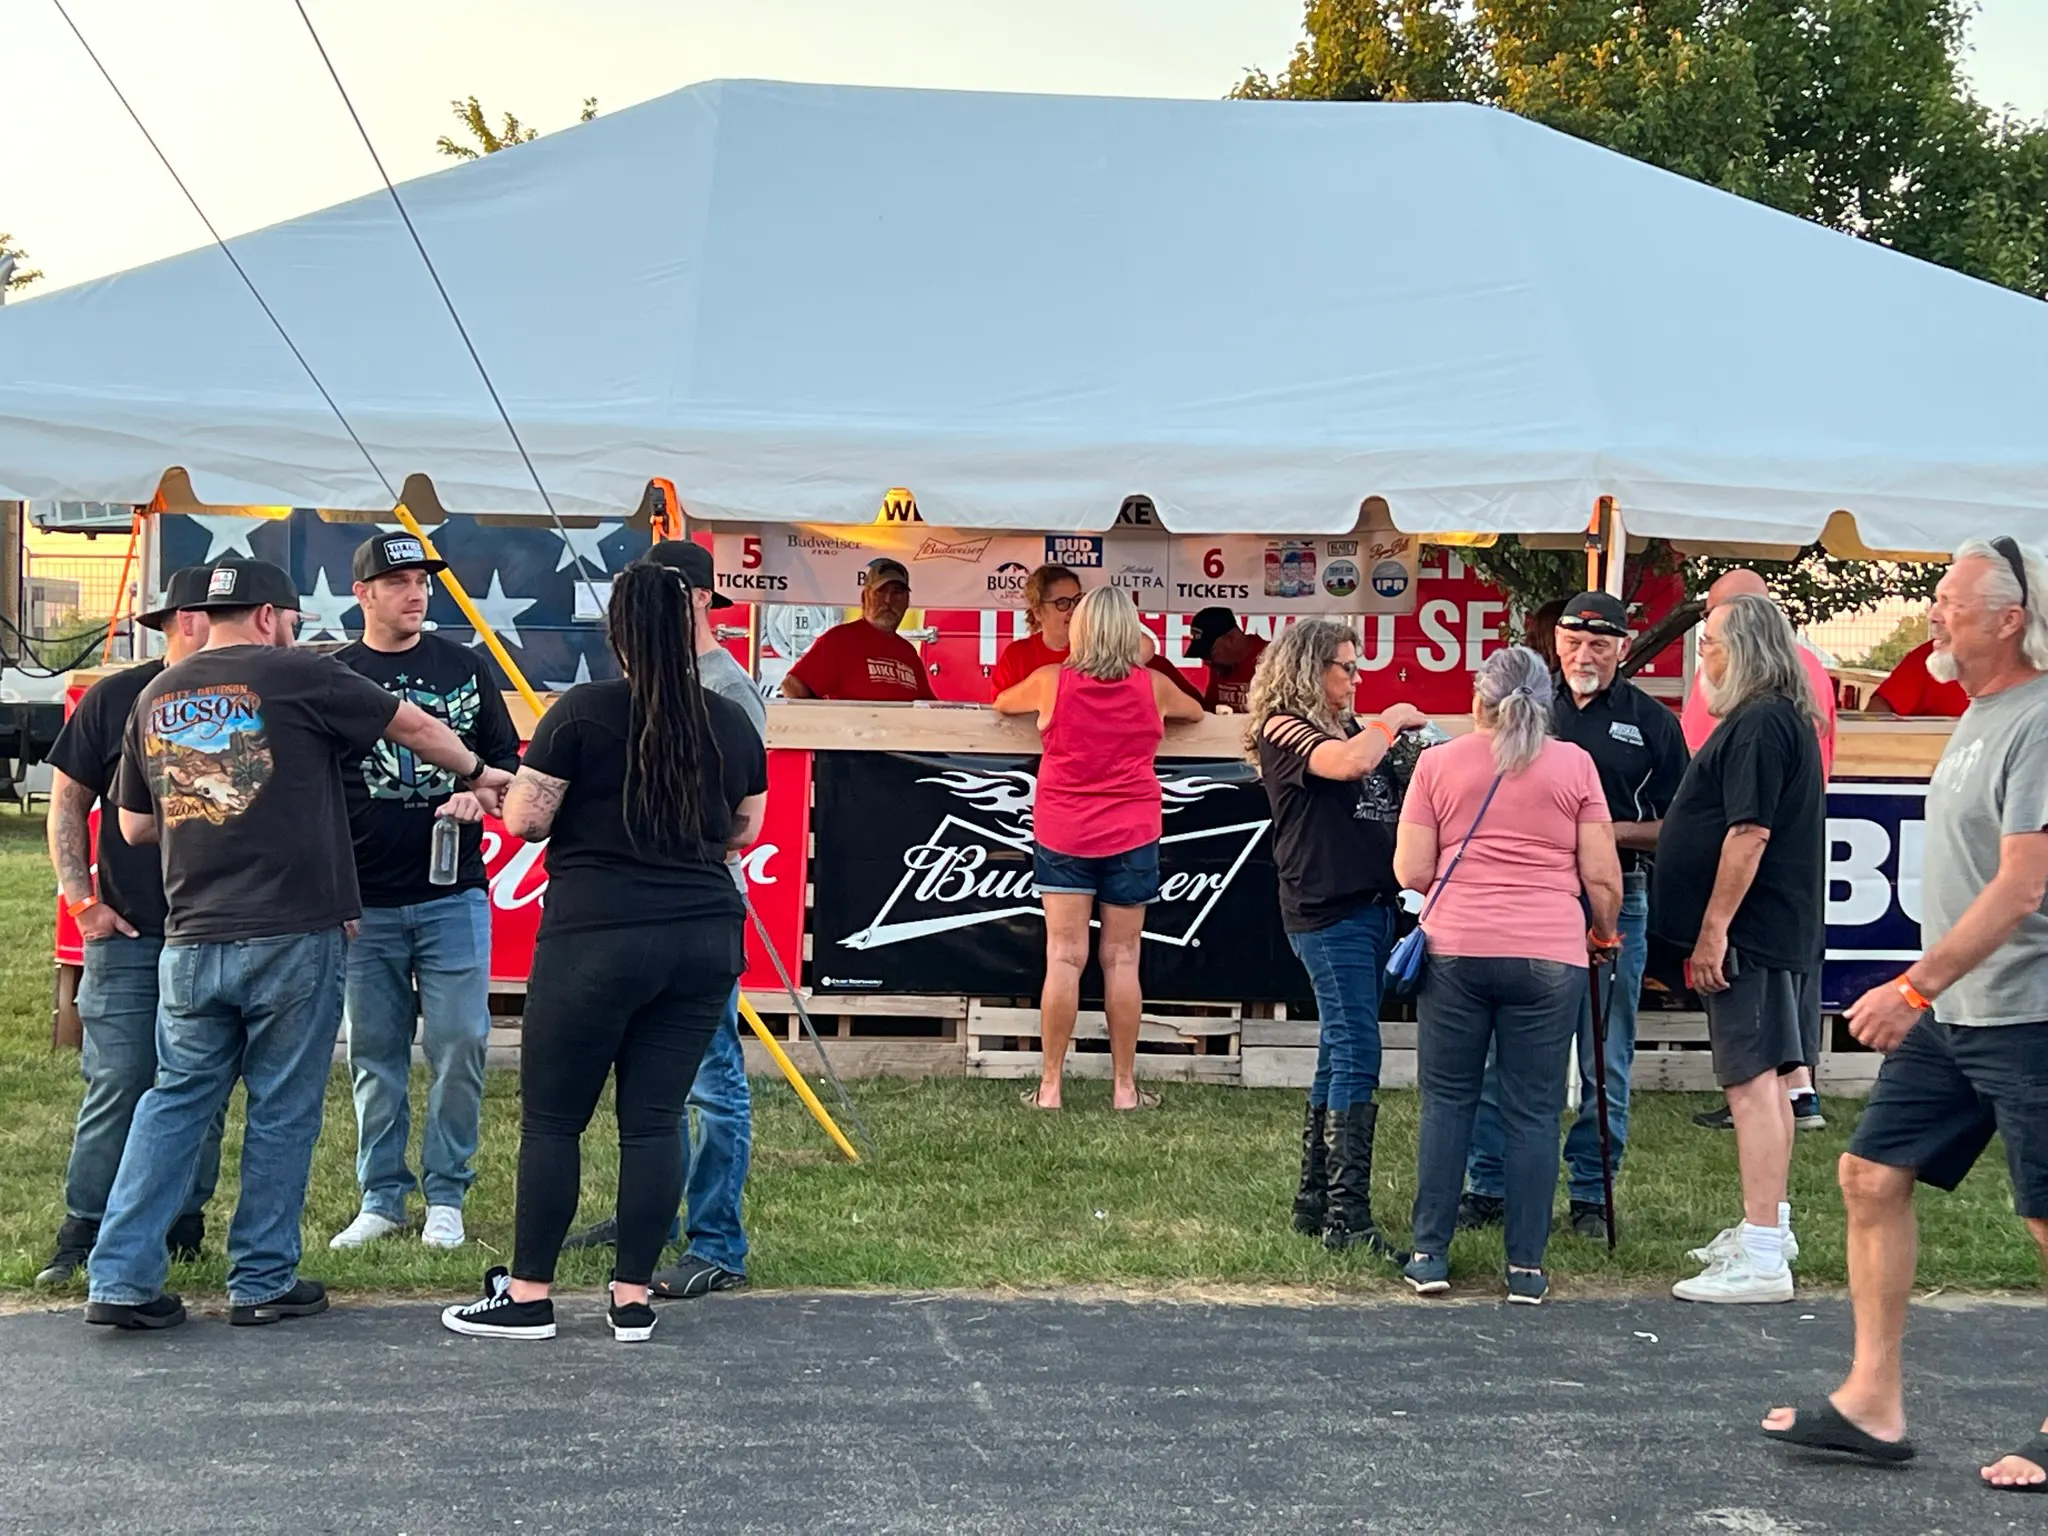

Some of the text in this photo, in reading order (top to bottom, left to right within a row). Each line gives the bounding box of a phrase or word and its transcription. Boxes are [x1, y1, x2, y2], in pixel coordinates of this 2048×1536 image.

[787, 535, 864, 550] Budweiser
[922, 543, 985, 556] Budweiser
[1055, 538, 1093, 552] BUD
[742, 537, 763, 569] 5
[1047, 551, 1100, 565] LIGHT
[1203, 548, 1225, 579] 6
[717, 573, 788, 591] TICKETS
[987, 575, 1027, 590] BUSC
[1110, 575, 1164, 588] ULTRA
[1176, 583, 1249, 599] TICKETS
[152, 695, 256, 734] TUCSON
